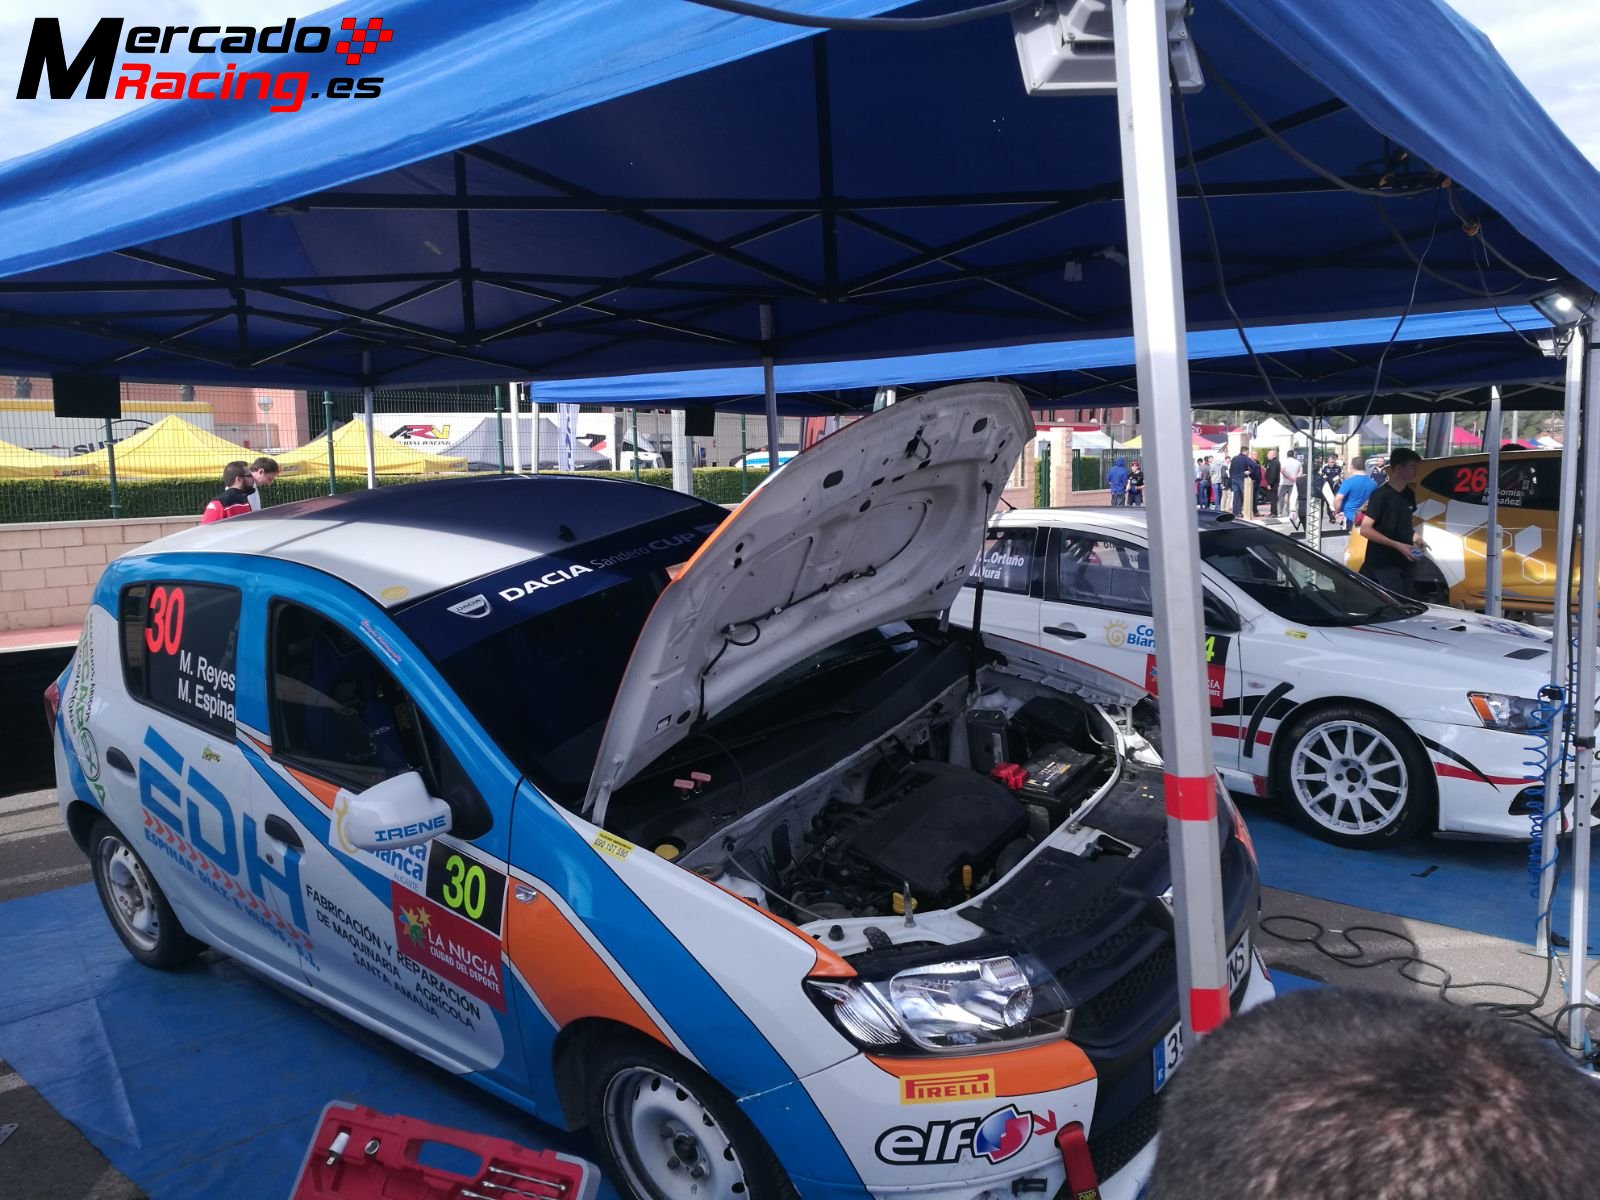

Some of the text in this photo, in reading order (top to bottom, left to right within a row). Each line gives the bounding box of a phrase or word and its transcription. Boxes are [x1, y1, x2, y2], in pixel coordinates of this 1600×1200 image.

[62, 468, 90, 477] SUZUKI
[1453, 467, 1489, 493] 26
[1496, 488, 1521, 497] omis
[590, 532, 697, 570] Sandero CUP
[498, 563, 594, 602] DACIA
[145, 585, 185, 657] 30
[455, 598, 482, 613] DACIA
[1126, 632, 1156, 648] Blan
[1136, 624, 1154, 637] Co
[179, 649, 236, 692] M. Reyes
[178, 677, 237, 724] M. Espina
[374, 815, 447, 842] IRENE
[144, 827, 195, 876] ESPINAR
[368, 848, 424, 882] anca
[442, 854, 487, 920] 30
[306, 883, 482, 1021] FABRICACIÓN Y REPARACIÓN
[428, 928, 445, 950] LA
[316, 908, 476, 1031] DE MAQUINARIA AGRÍCOLA
[352, 951, 441, 1020] SANTA AMALIA
[430, 946, 501, 994] CIUDAD DEL DEPORTE
[905, 1073, 990, 1100] PIRELLI
[874, 1117, 982, 1166] elf
